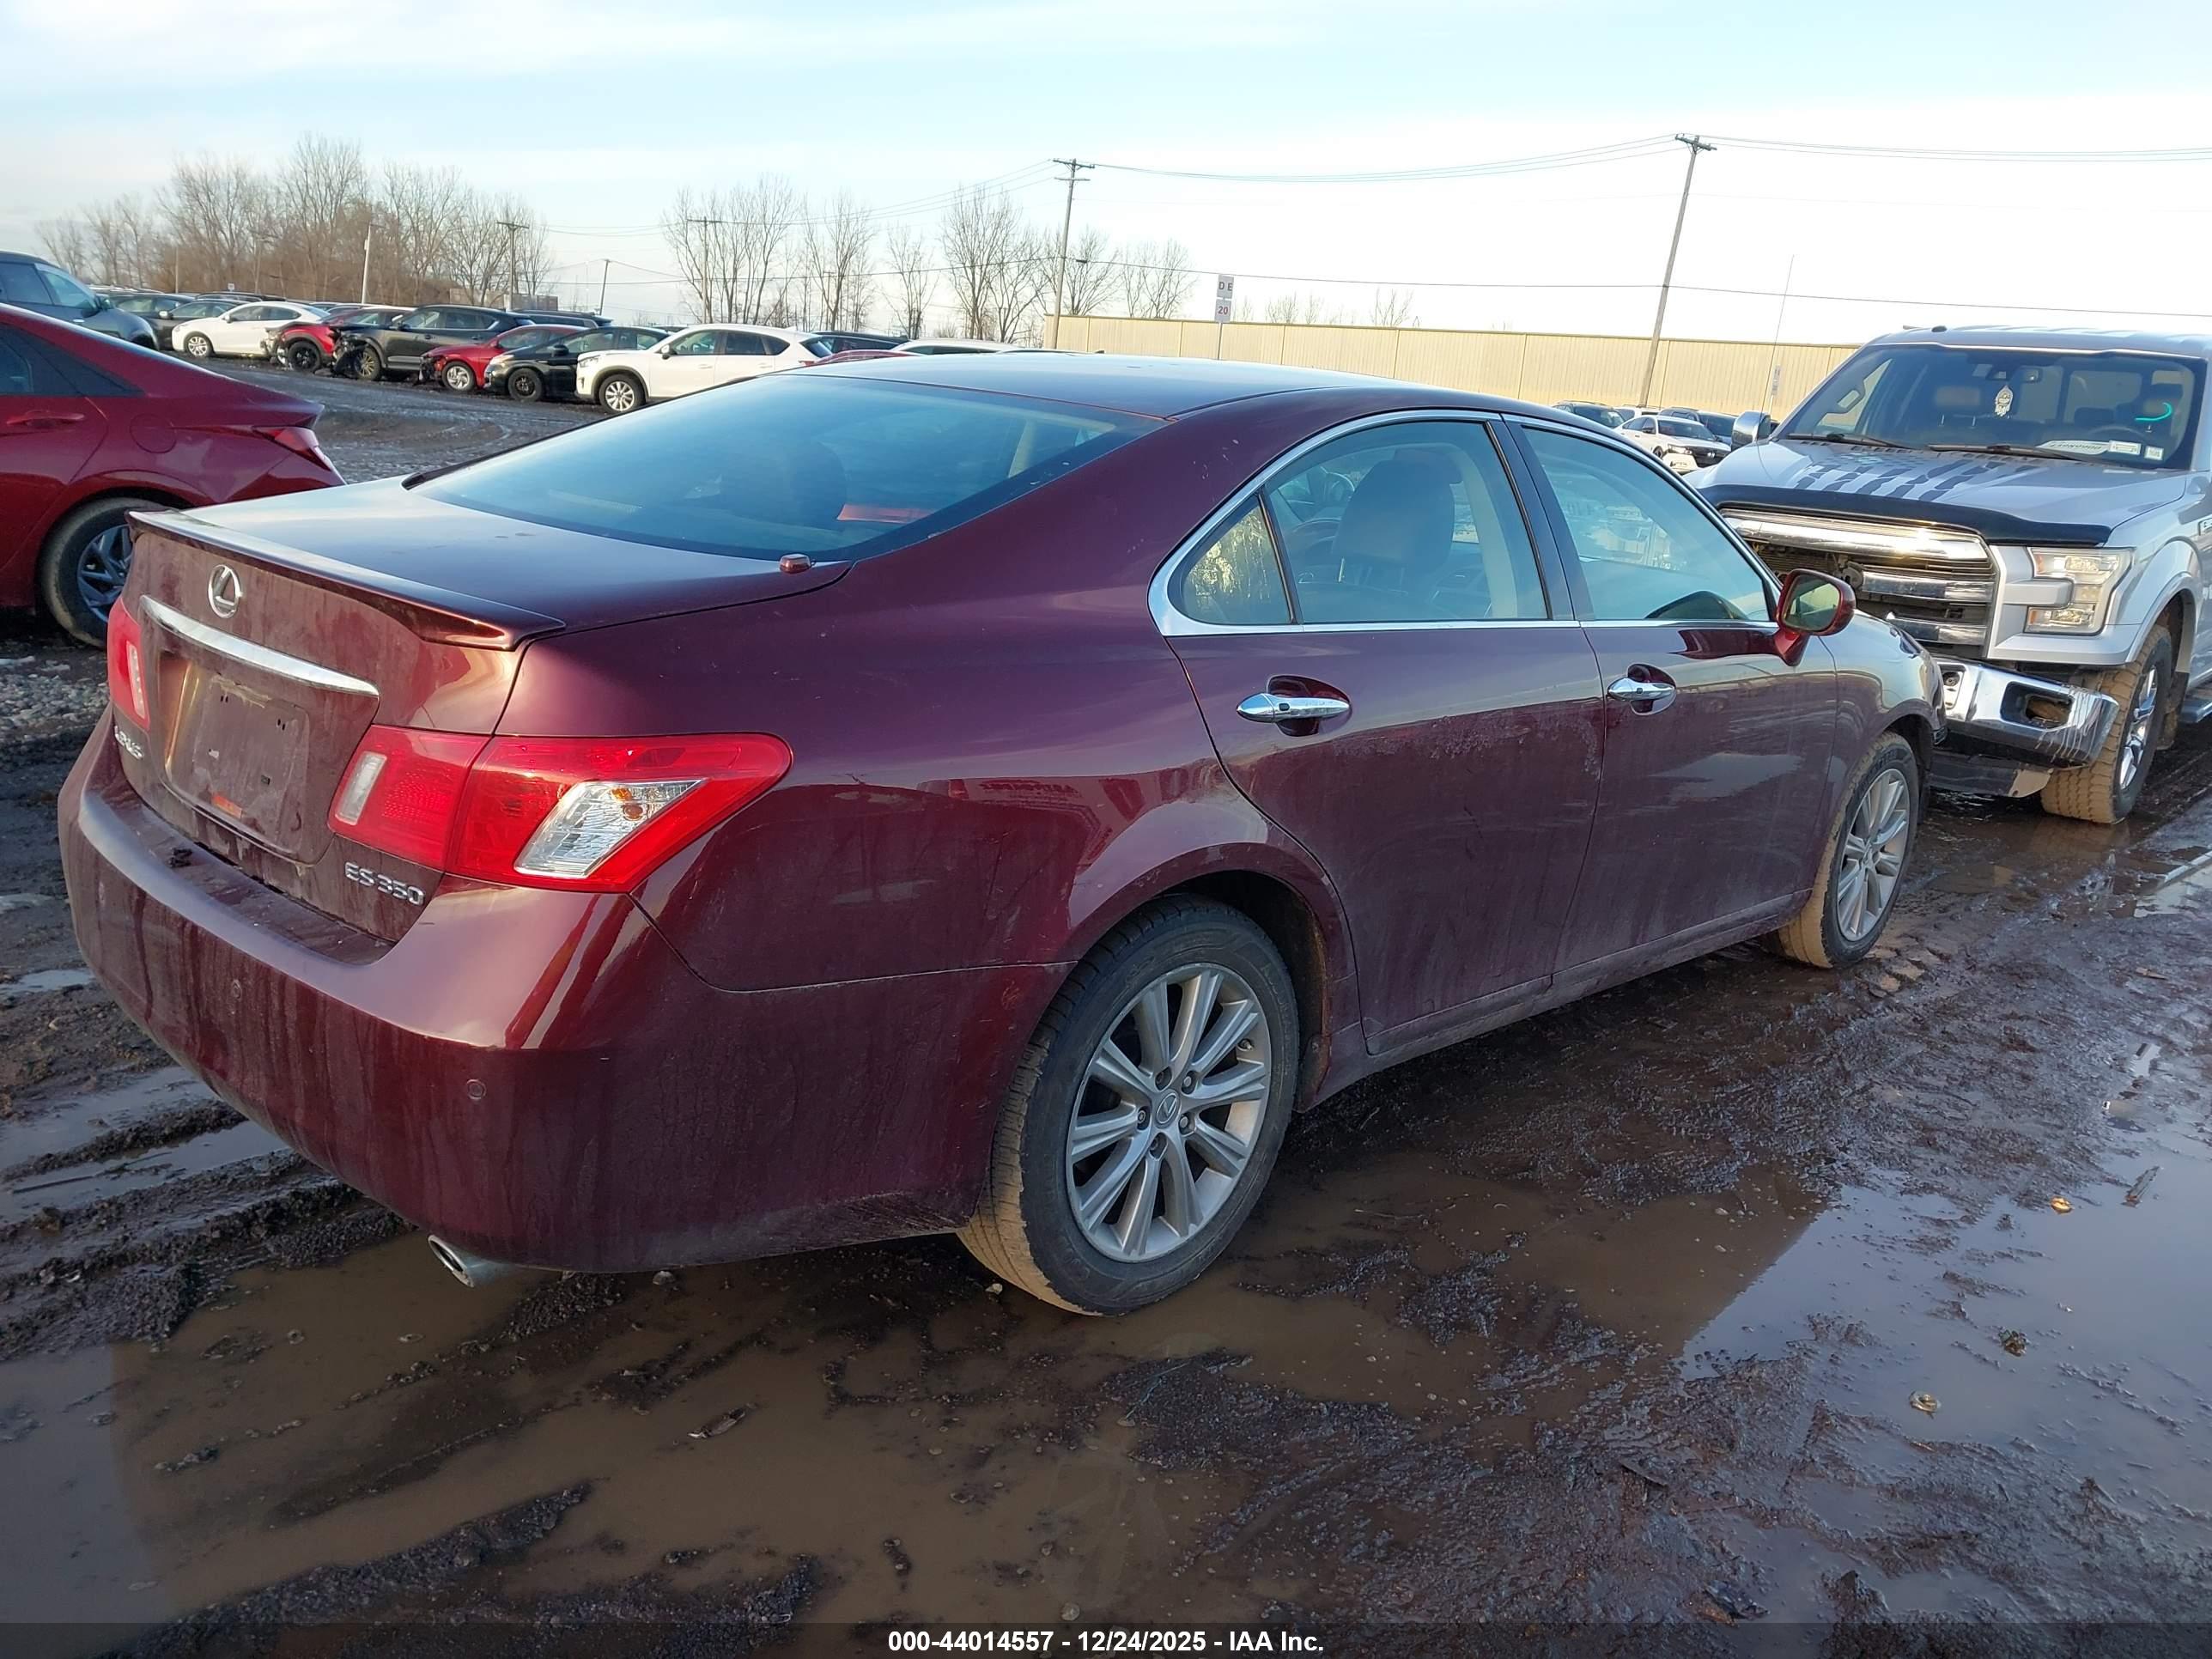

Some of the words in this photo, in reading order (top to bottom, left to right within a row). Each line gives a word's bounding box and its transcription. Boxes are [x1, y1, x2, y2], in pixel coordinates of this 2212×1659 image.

[1218, 281, 1225, 290] D
[1227, 283, 1234, 292] E
[1218, 305, 1229, 315] 20
[344, 861, 375, 886] ES
[377, 874, 425, 906] 350
